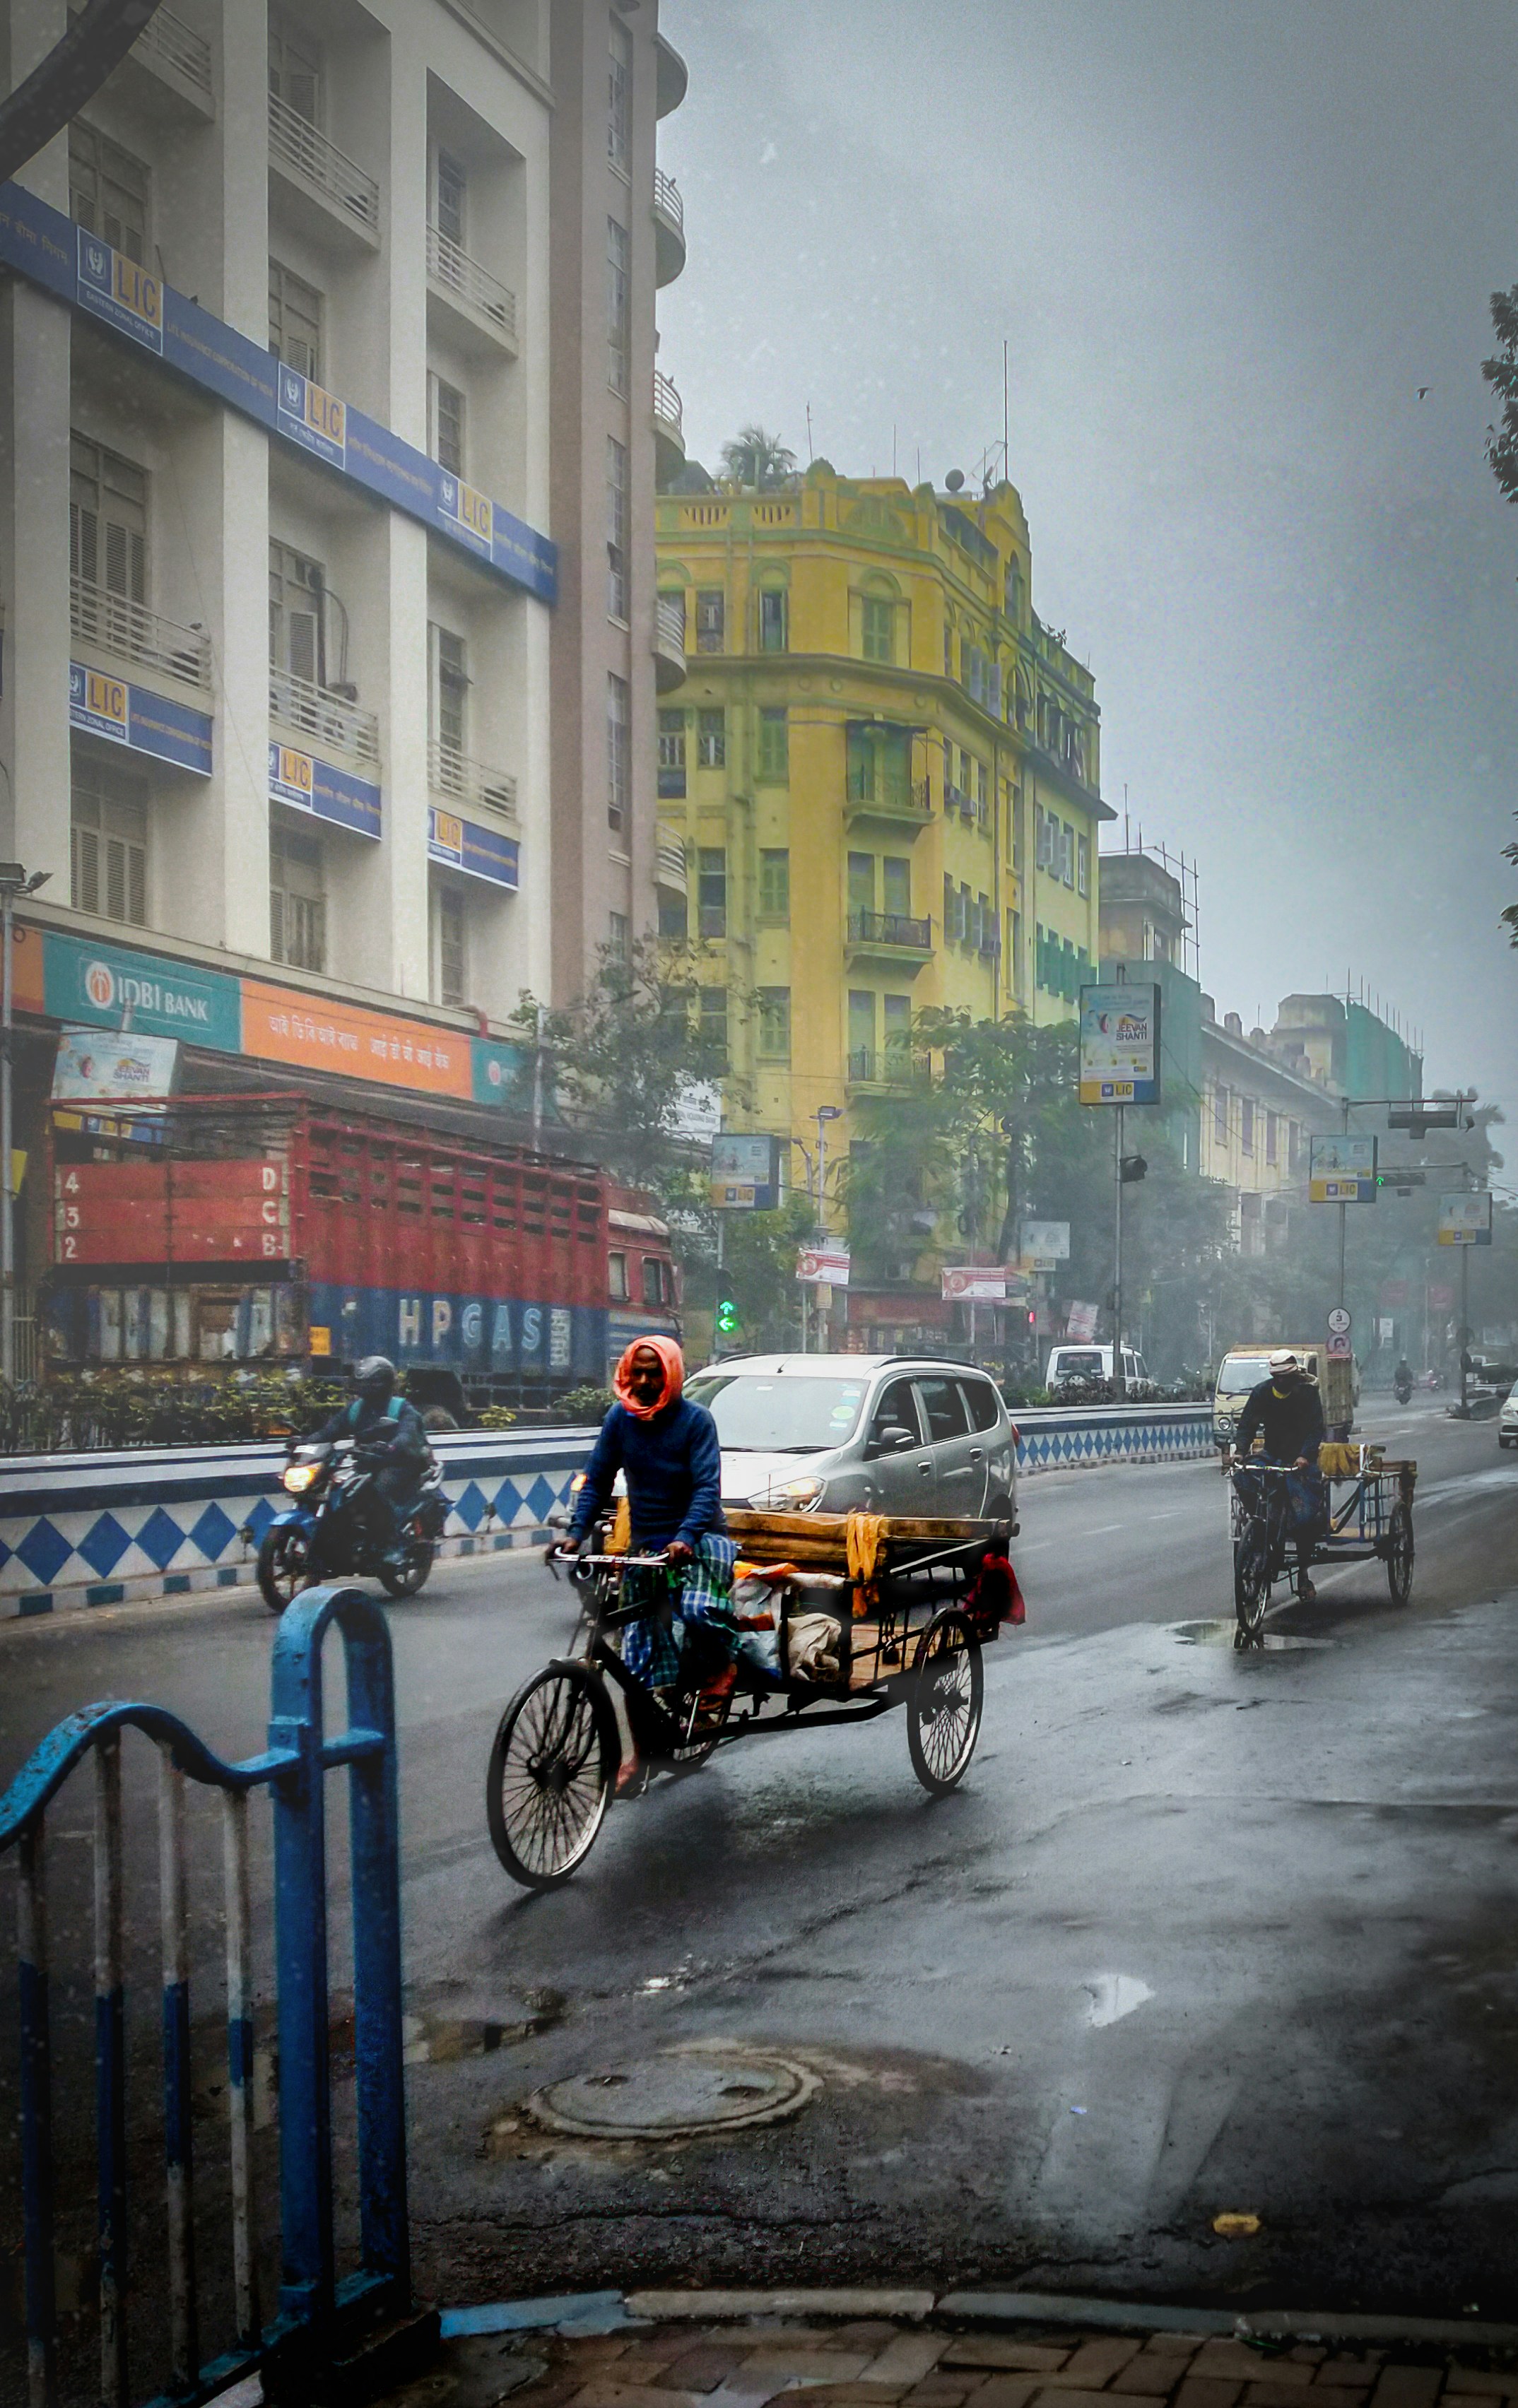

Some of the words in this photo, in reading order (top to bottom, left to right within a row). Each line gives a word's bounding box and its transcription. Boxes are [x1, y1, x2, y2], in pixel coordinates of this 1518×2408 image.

[118, 260, 155, 317] LIC
[310, 389, 340, 438] LIC
[462, 488, 488, 533] LIC
[91, 678, 122, 717] LIC
[284, 752, 308, 787] LIC
[438, 814, 459, 846] LIC
[118, 976, 160, 1011] IDBI
[165, 991, 208, 1022] BANK
[1116, 1023, 1147, 1032] JEEVAN
[1116, 1032, 1147, 1041] SHANTI
[112, 1072, 149, 1082] SHANTI
[113, 1066, 151, 1075] JEEVAN
[1115, 1083, 1131, 1095] LIC
[65, 1172, 79, 1193] 4
[262, 1167, 276, 1190] D
[1340, 1184, 1356, 1195] LIC
[66, 1207, 79, 1227] 3
[262, 1201, 276, 1223] C
[65, 1237, 78, 1258] 2
[262, 1234, 276, 1256] B
[399, 1299, 452, 1345] HP
[461, 1303, 542, 1350] GAS
